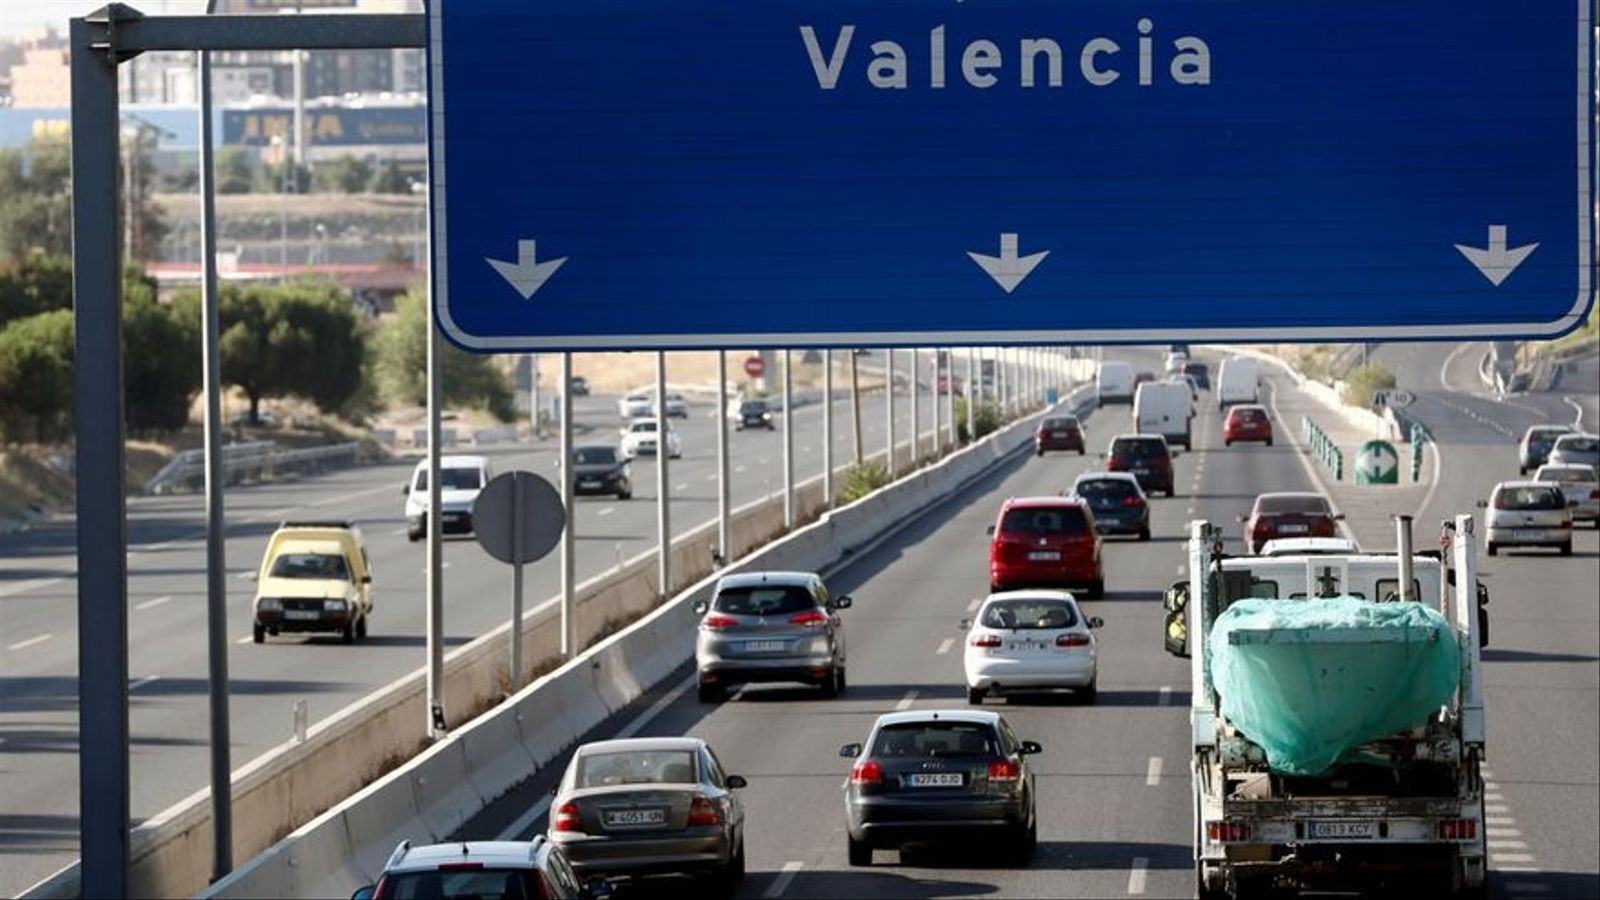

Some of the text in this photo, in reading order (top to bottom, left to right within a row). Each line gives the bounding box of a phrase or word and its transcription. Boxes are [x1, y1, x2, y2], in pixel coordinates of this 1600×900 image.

[799, 18, 1212, 90] Valencia
[1318, 823, 1370, 835] 0813 KCY
